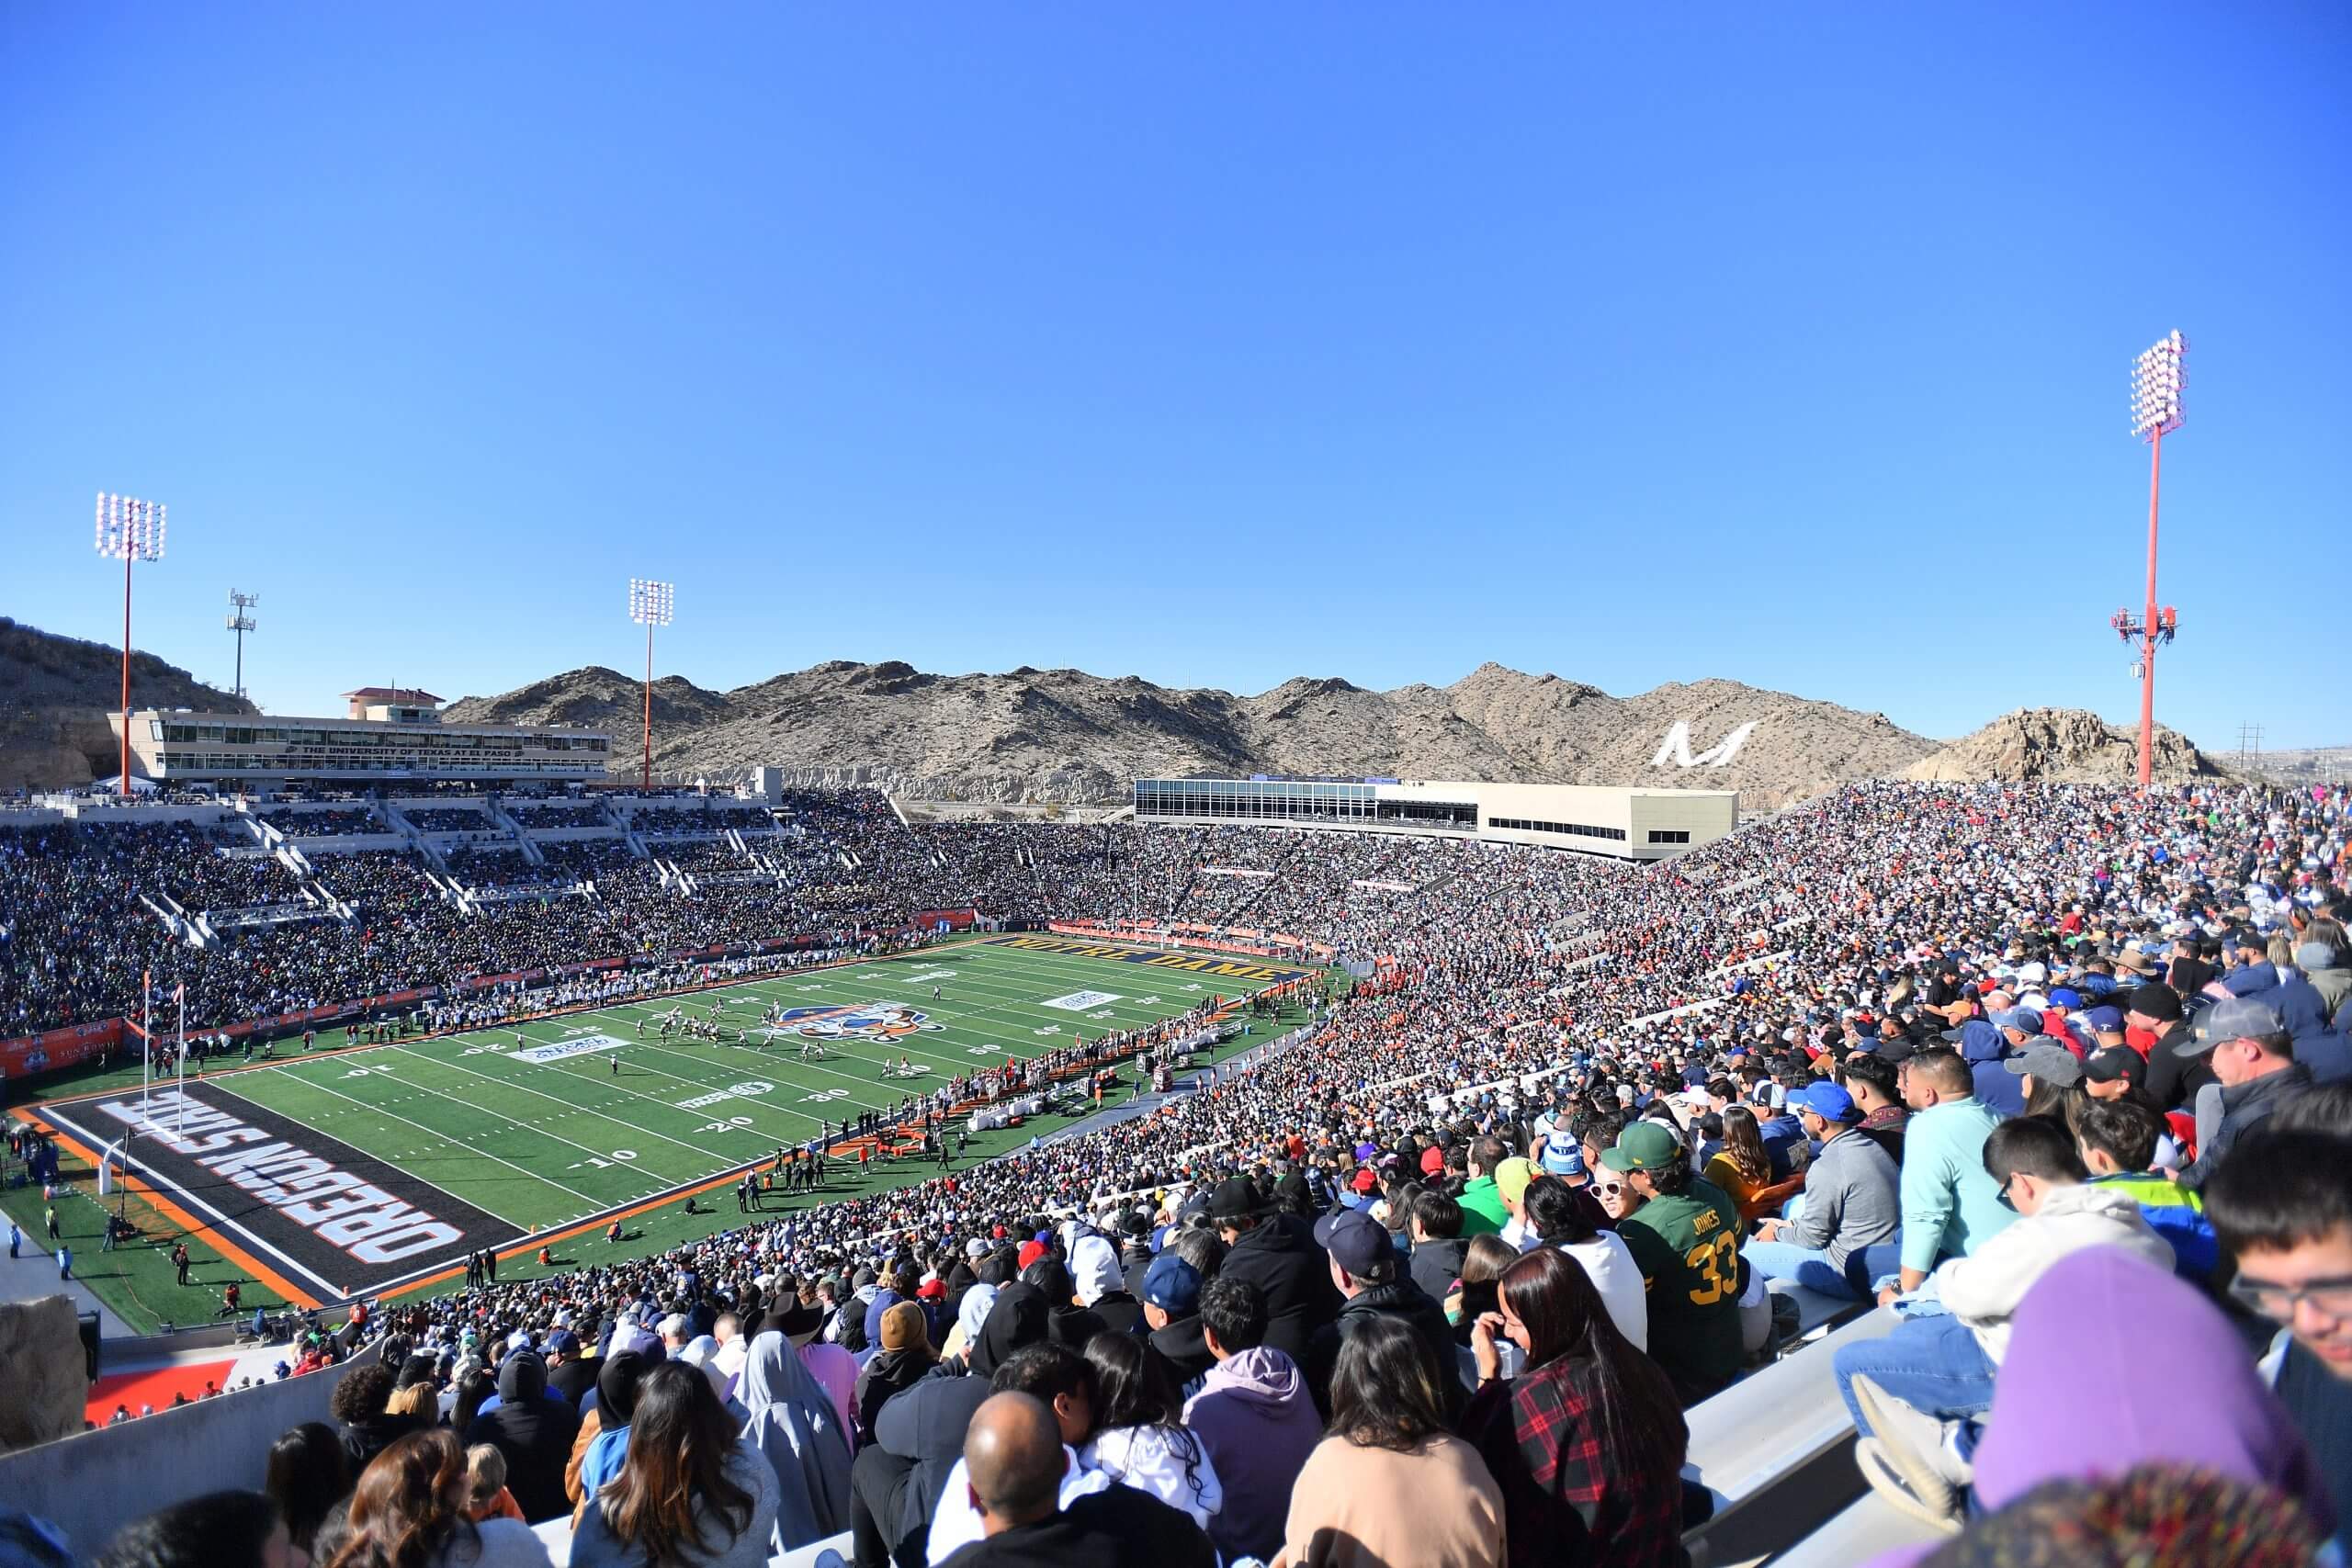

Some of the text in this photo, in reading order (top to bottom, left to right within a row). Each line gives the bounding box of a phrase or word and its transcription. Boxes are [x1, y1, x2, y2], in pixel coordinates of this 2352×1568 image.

[1003, 937, 1291, 981] NOTRE DAME
[967, 1044, 1002, 1055] 50
[347, 1064, 396, 1079] 10
[808, 1089, 850, 1102] 30
[706, 1116, 753, 1134] 20
[588, 1149, 638, 1170] 10
[96, 1089, 466, 1265] OREGON STATE
[1692, 1209, 1721, 1236] JONES
[1687, 1229, 1738, 1305] 33
